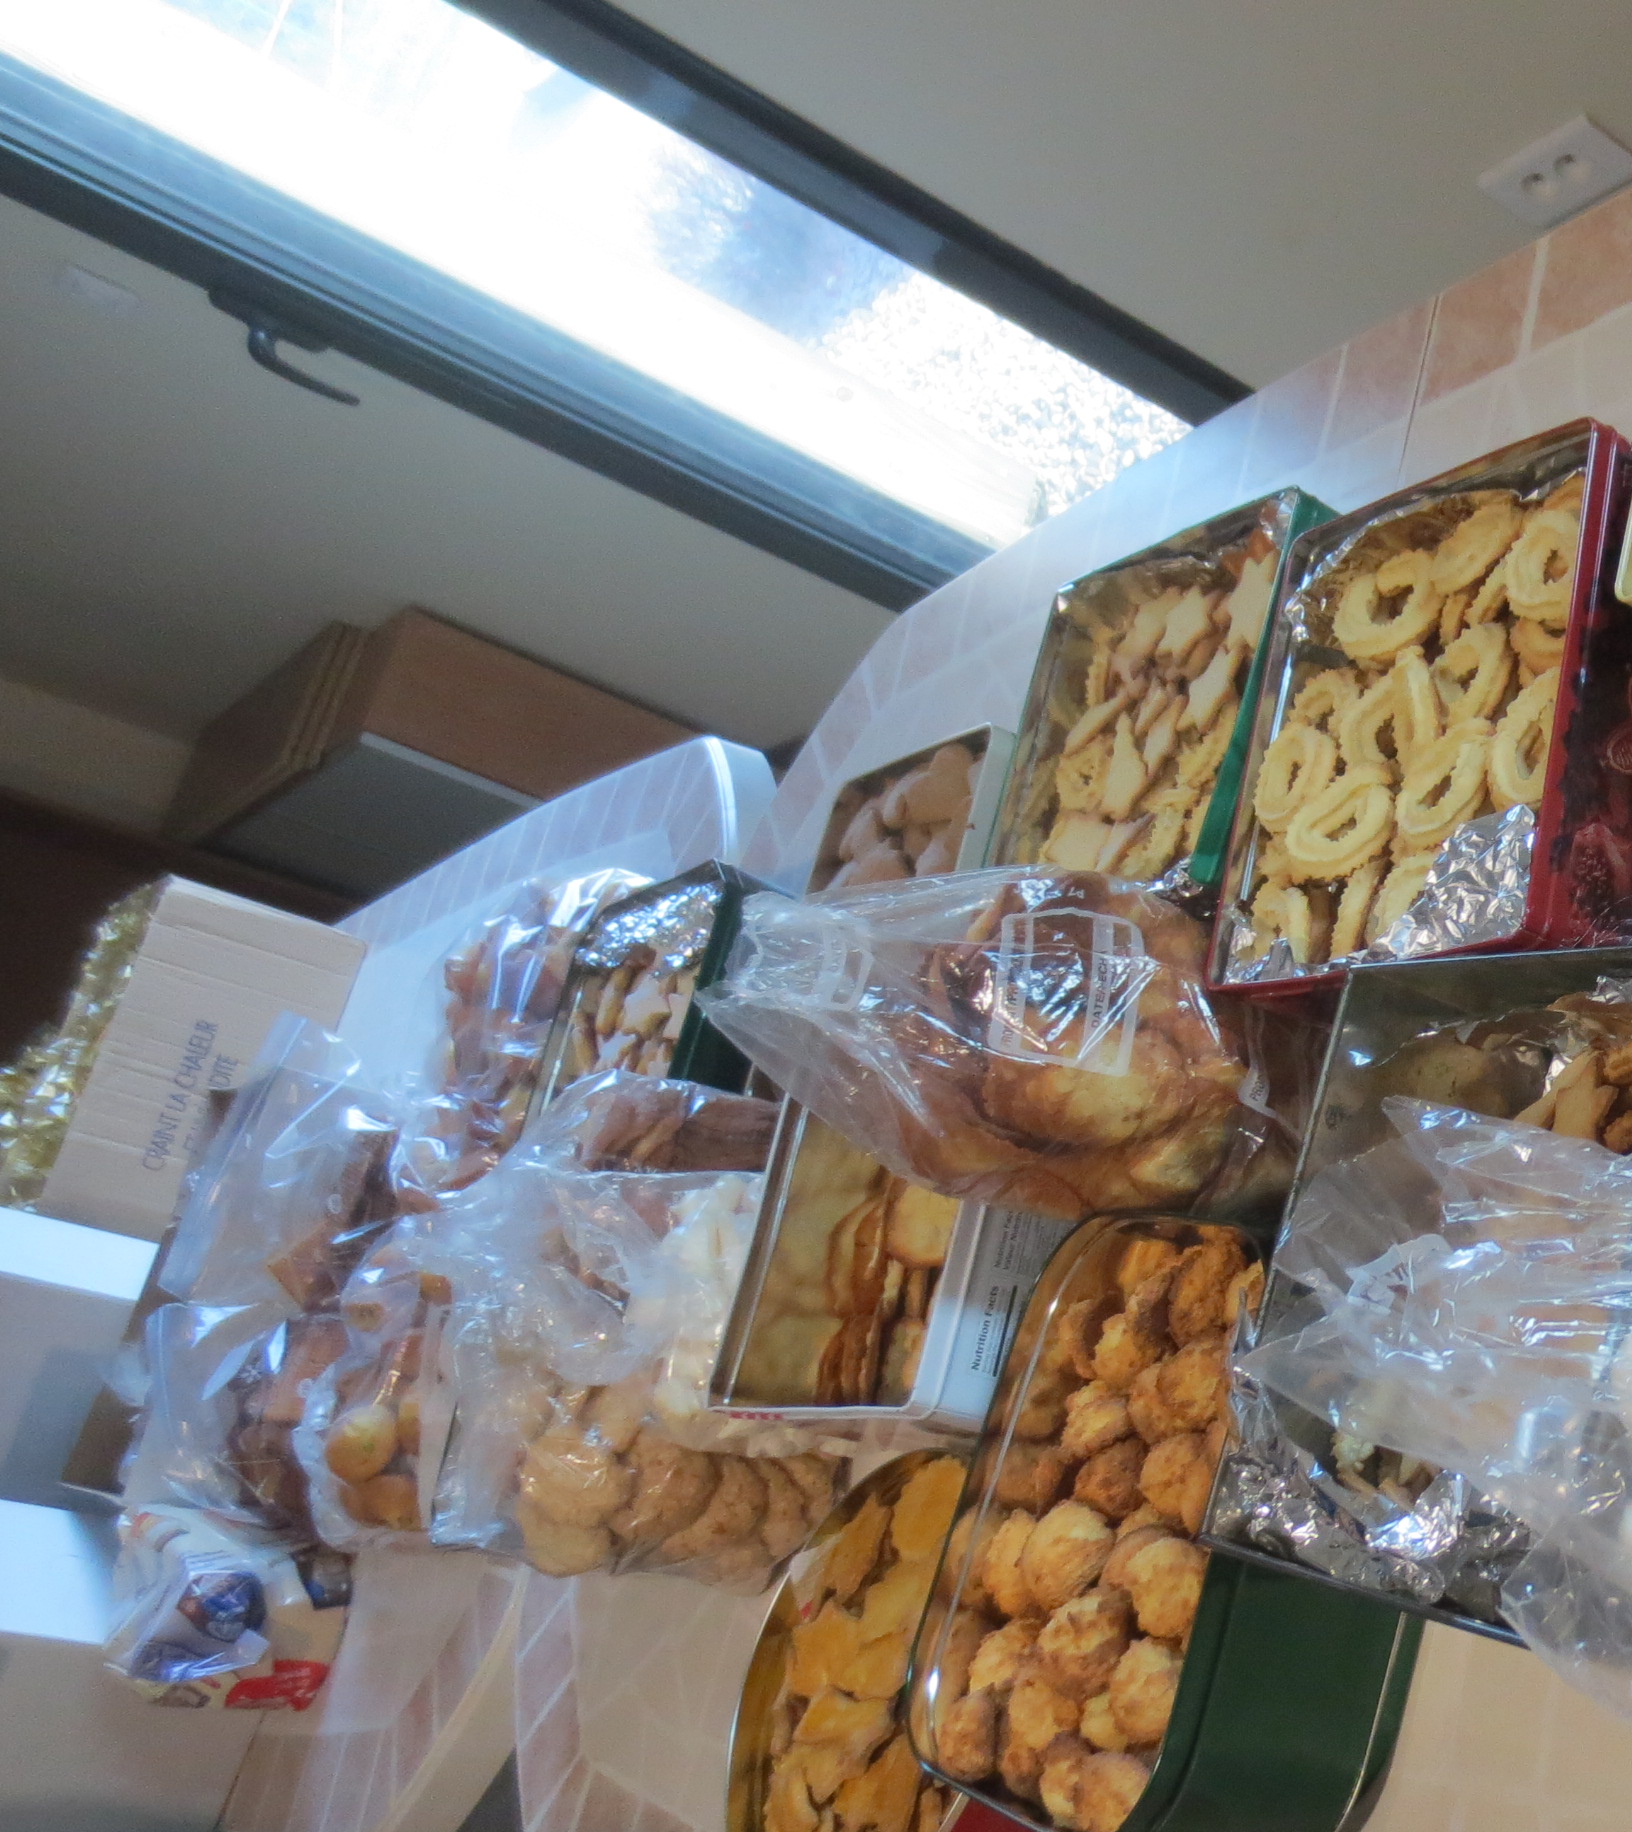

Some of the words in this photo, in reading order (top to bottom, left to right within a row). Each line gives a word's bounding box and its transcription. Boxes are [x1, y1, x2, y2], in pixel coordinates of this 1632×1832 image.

[174, 1019, 218, 1089] CHALEUR
[165, 1093, 190, 1113] LA
[142, 1112, 181, 1171] CRAINT
[971, 1318, 991, 1371] Nutrition
[985, 1285, 999, 1317] Facts
